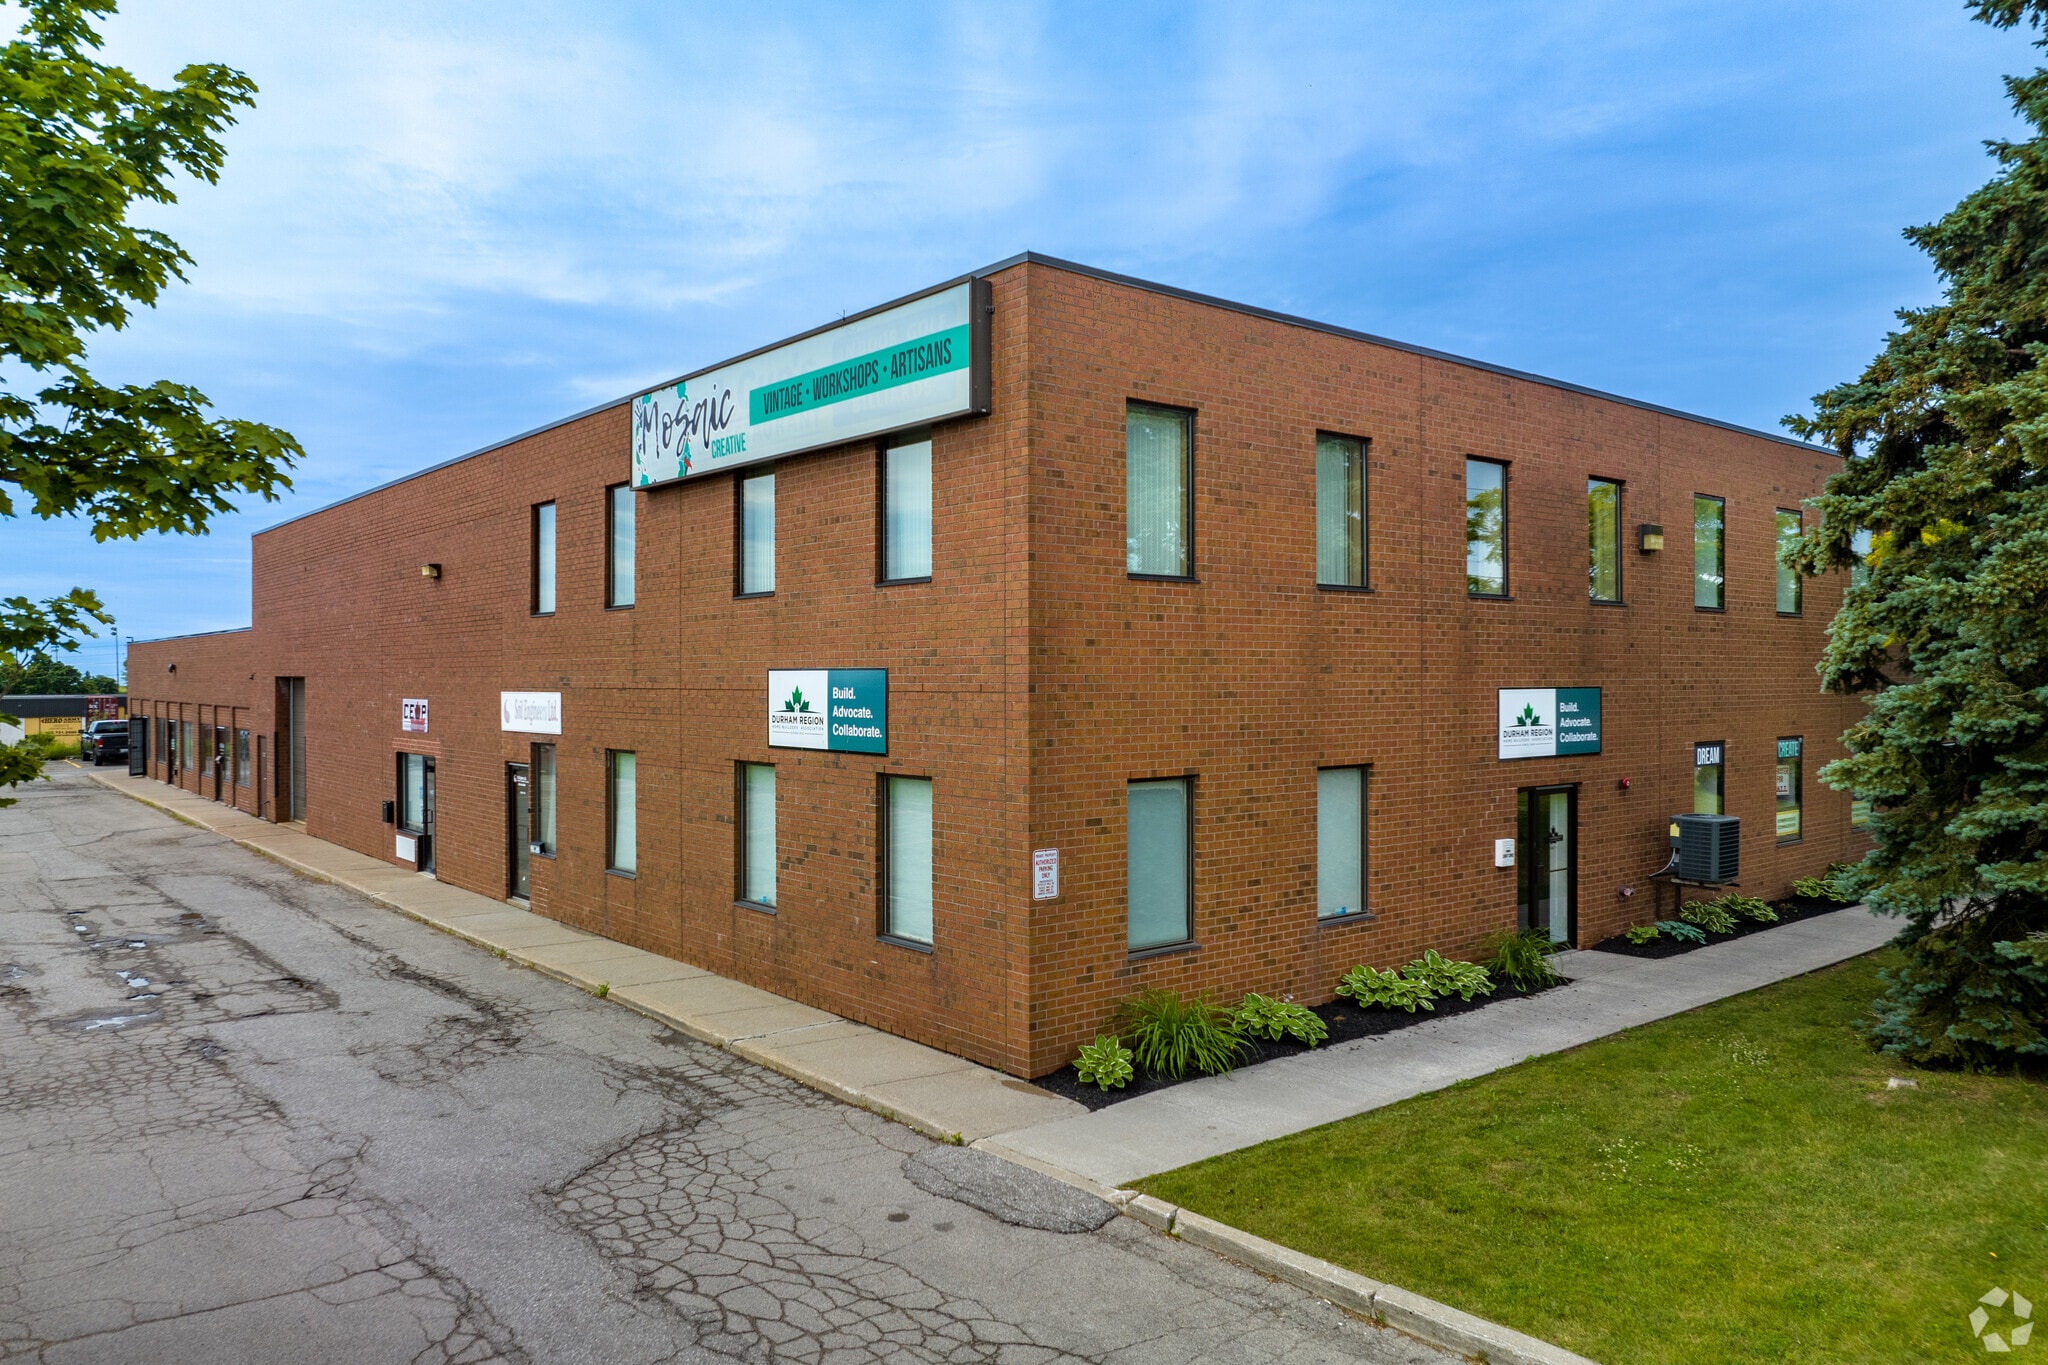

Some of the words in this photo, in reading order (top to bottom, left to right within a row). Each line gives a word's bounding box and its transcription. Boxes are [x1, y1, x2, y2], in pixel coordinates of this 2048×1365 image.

[763, 382, 803, 415] VINTAGE
[812, 359, 879, 401] WORKSHOPS
[890, 337, 952, 380] ARTISANS
[640, 384, 735, 459] Mosaic
[711, 432, 747, 460] CREATIVE
[832, 687, 856, 700] Build.
[832, 705, 873, 719] Advocate.
[1560, 702, 1579, 712] Build.
[772, 714, 798, 725] DURHAM
[800, 716, 824, 726] REGION
[1560, 718, 1592, 727] Advocate.
[832, 723, 883, 738] Collaborate.
[1504, 730, 1529, 738] DURHAM
[1531, 728, 1552, 736] REGION
[1560, 732, 1598, 742] Collaborate.
[1697, 746, 1720, 766] DREAM
[1778, 740, 1799, 758] CREATE
